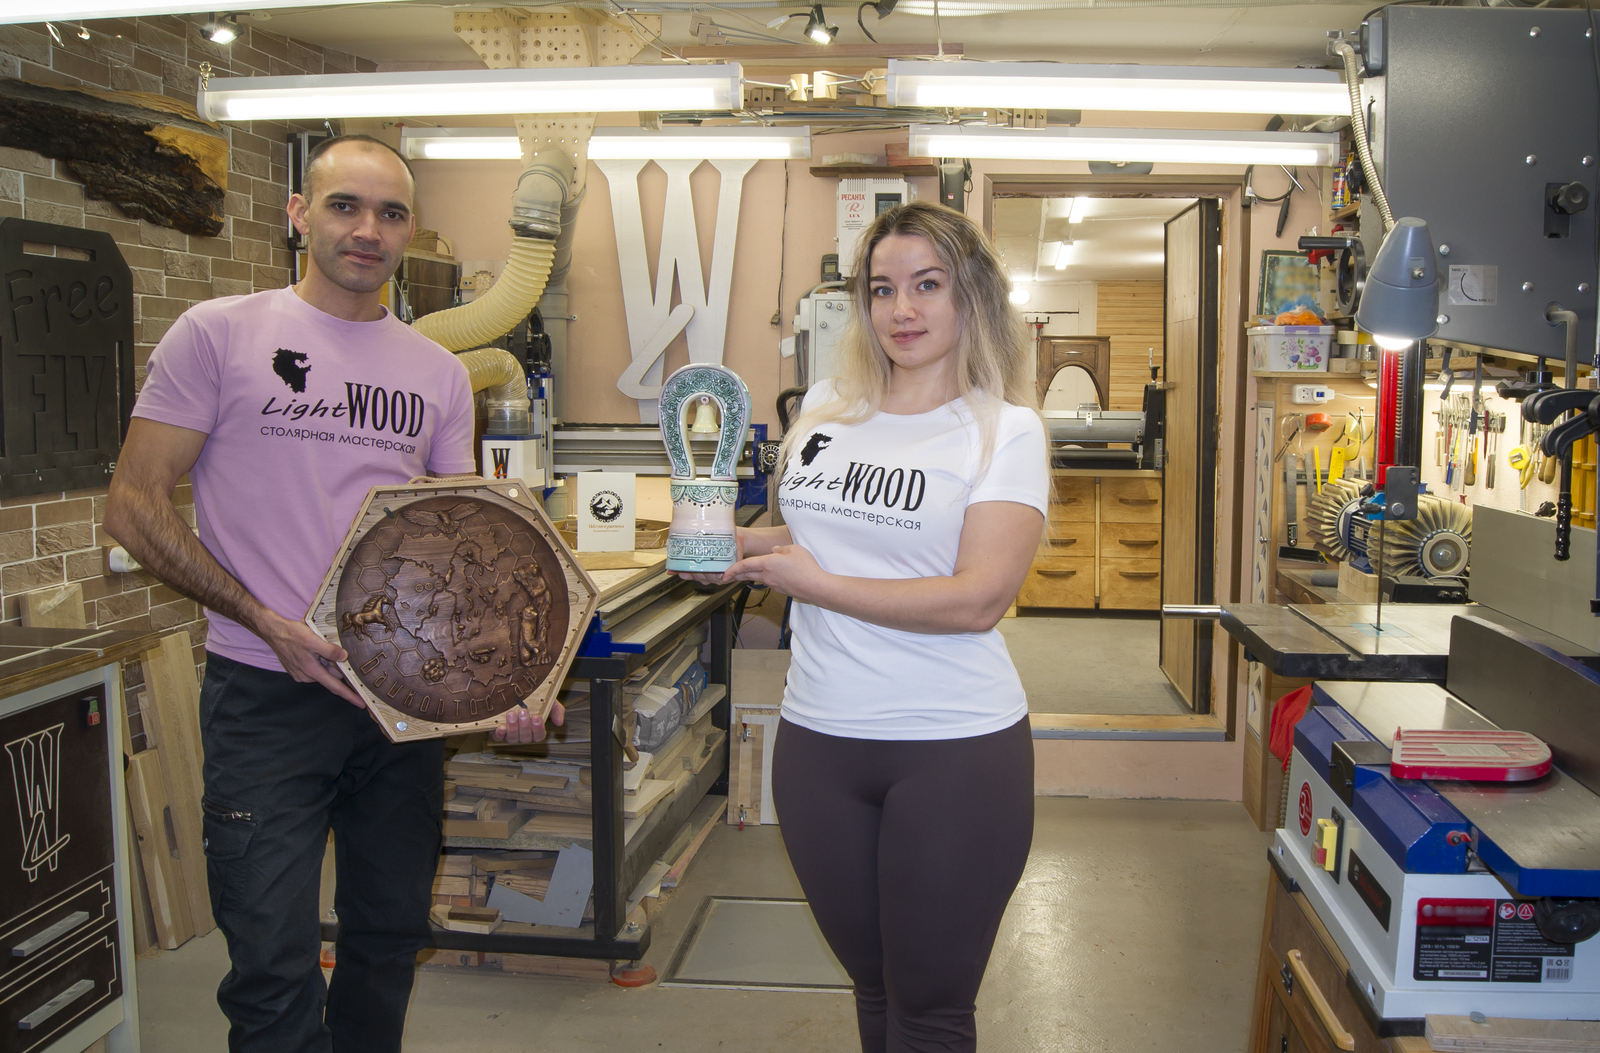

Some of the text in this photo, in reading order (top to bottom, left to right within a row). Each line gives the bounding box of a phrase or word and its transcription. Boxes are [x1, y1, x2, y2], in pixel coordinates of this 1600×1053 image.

[4, 269, 118, 345] Free
[15, 354, 106, 458] FLY
[260, 426, 416, 455] столярная мастерская
[831, 506, 921, 531] мастерская
